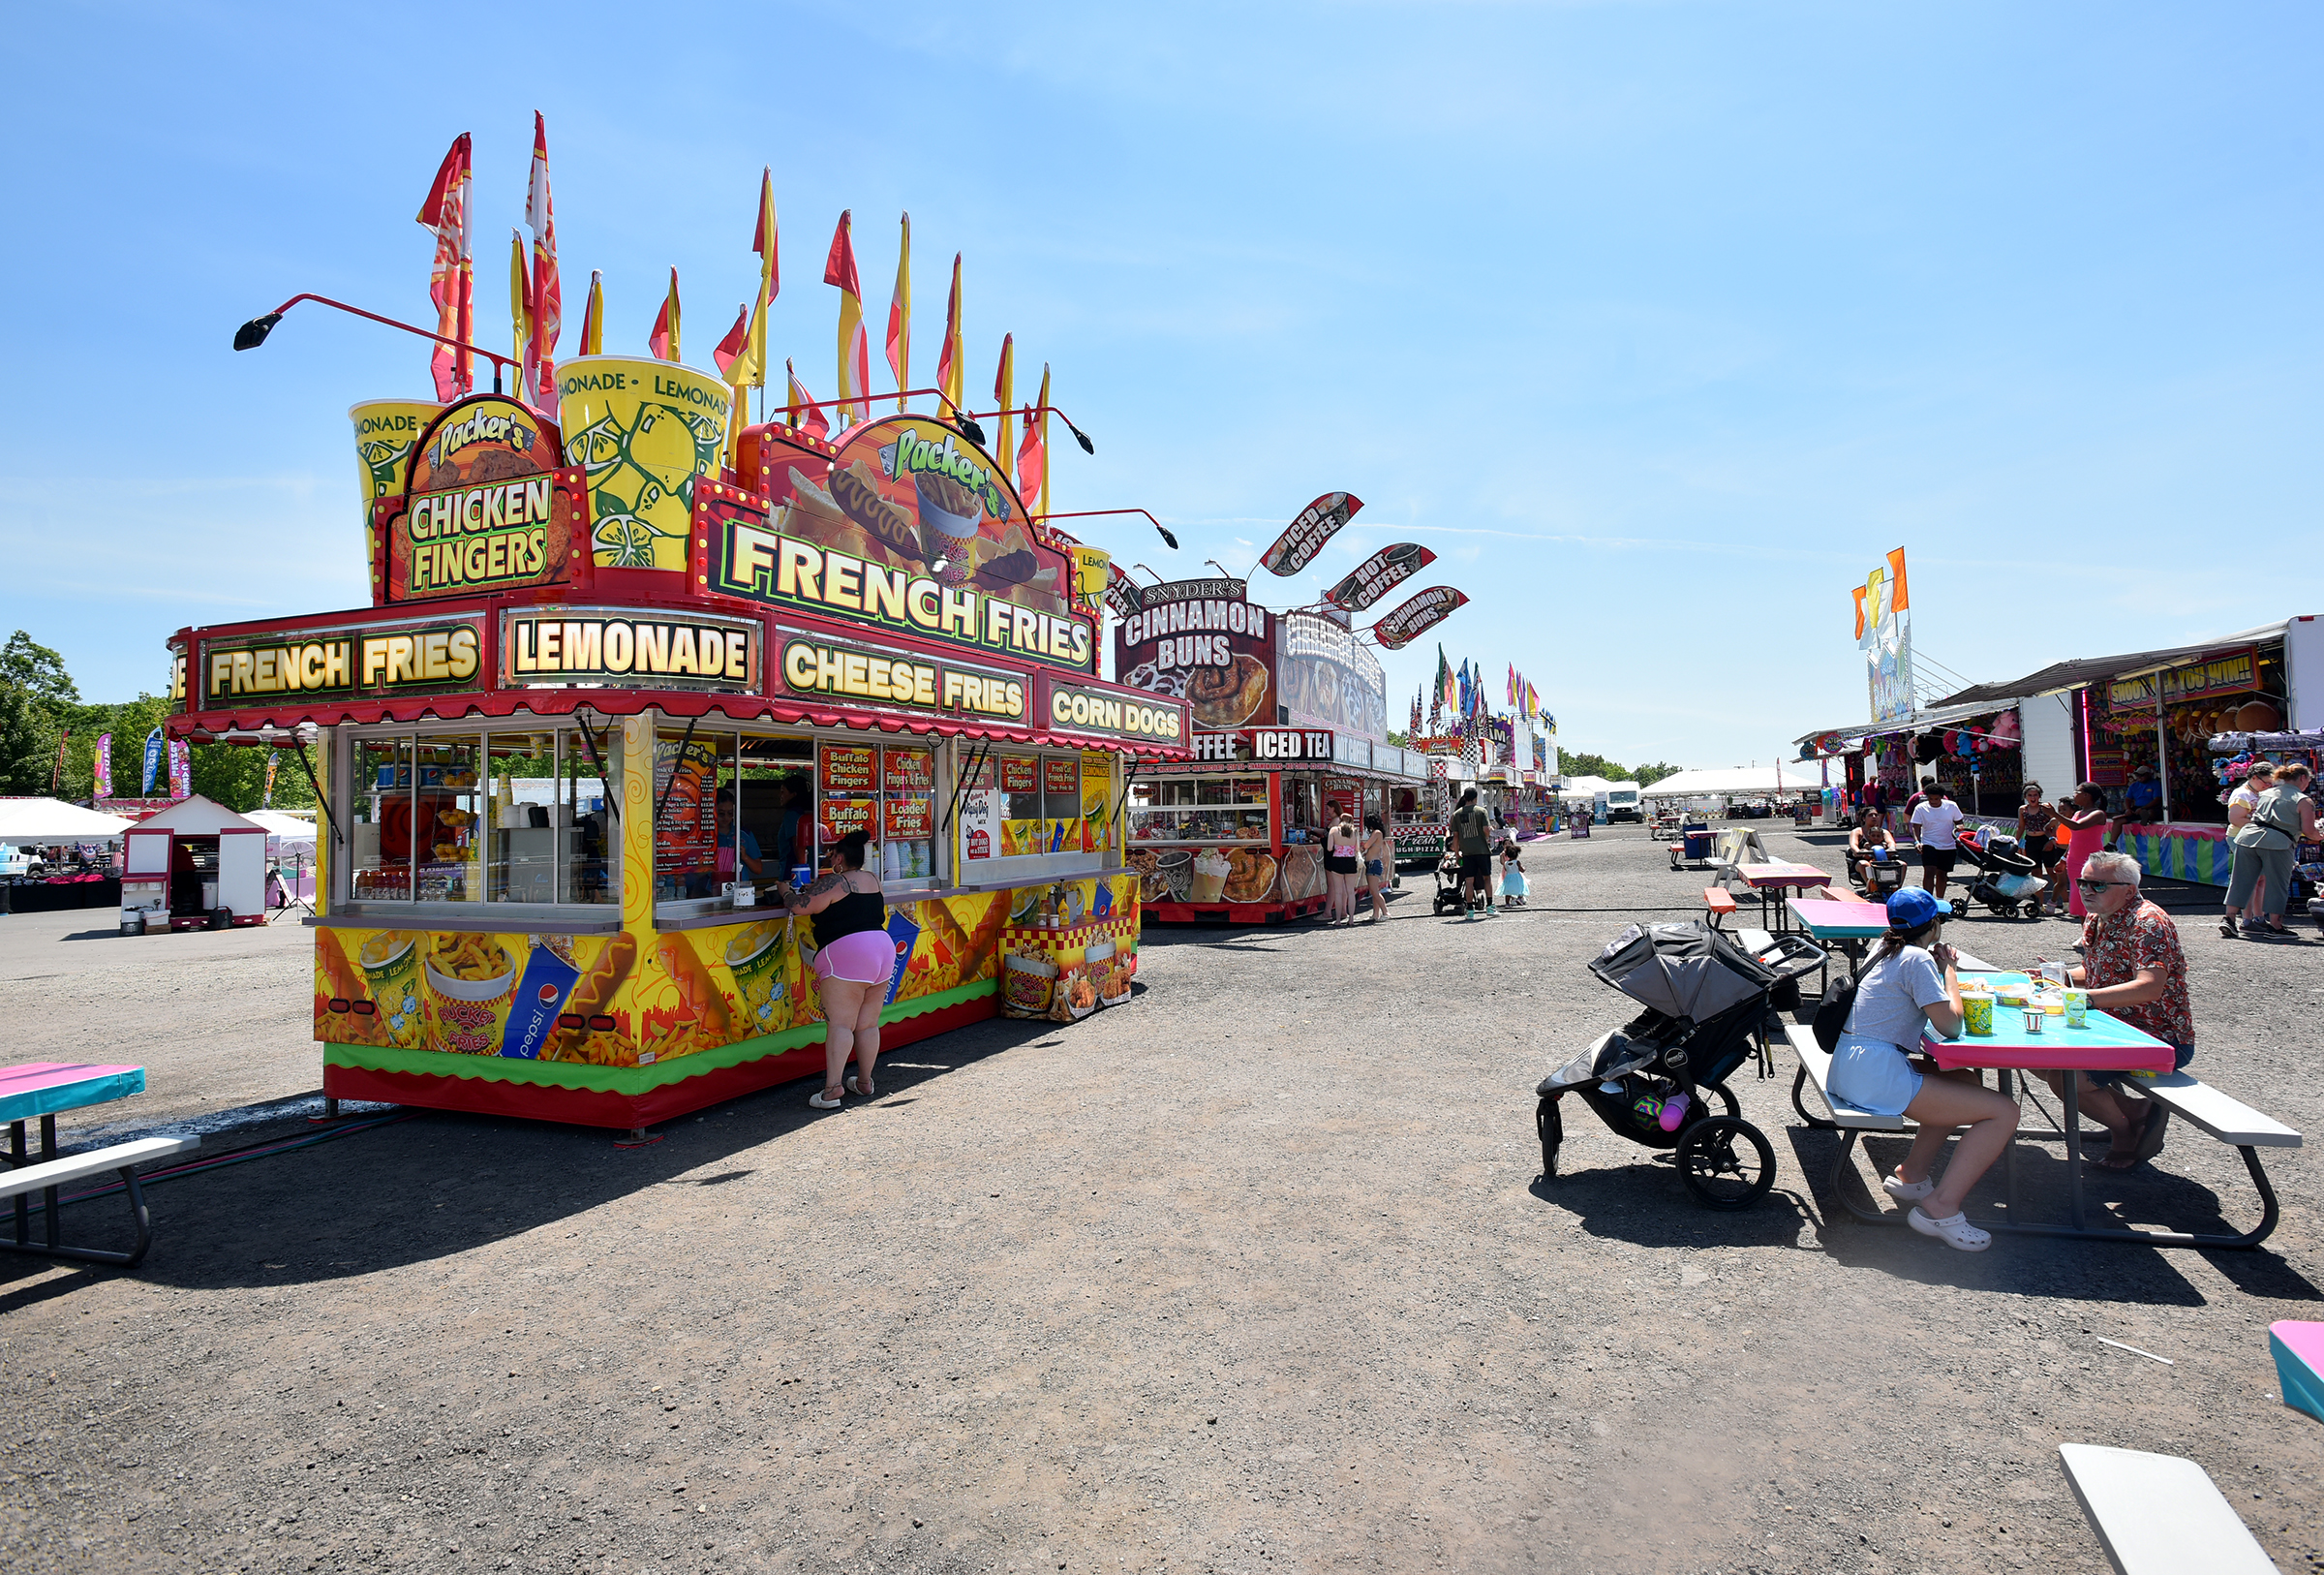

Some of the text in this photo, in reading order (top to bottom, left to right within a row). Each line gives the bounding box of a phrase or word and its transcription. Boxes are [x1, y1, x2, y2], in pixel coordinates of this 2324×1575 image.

[558, 373, 626, 400] EMONADE
[354, 417, 417, 436] EMONADE
[439, 407, 524, 468] Packer's
[892, 428, 1000, 520] Packer's
[412, 479, 550, 540] CHICKEN
[1284, 508, 1320, 548] ICED
[1290, 515, 1339, 571] COFFEE
[413, 529, 547, 590] FINGERS
[1083, 555, 1108, 571] LEMON
[1355, 553, 1388, 586] HOT
[941, 567, 965, 581] RIES
[1357, 562, 1411, 608] COFFEE
[732, 523, 1090, 664] FRENCH FRIES
[1104, 586, 1130, 616] FFEE
[1145, 579, 1242, 604] SNYDER'S
[1125, 601, 1266, 646] CINNAMON
[1391, 590, 1447, 633] CINNAMON
[1406, 606, 1440, 633] BUNS
[210, 641, 350, 695] FRENCH
[364, 629, 477, 686] FRIES
[516, 623, 746, 678] LEMONADE
[1157, 635, 1232, 670] BUNS
[785, 645, 1024, 718] CHEESE FRIES
[2178, 664, 2205, 692] YOU
[2208, 656, 2250, 686] WIN!!
[1053, 690, 1180, 740] CORN DOGS
[657, 740, 709, 763] Pacer's
[830, 752, 869, 763] Buffalo
[1193, 733, 1238, 760] FFEE
[1256, 731, 1330, 758] ICED TEA
[830, 762, 870, 775] Chicken
[897, 757, 921, 771] Chicken
[960, 762, 991, 775] Mzzaella
[1006, 764, 1032, 776] Chicken
[1052, 764, 1063, 773] Fresh
[1083, 765, 1110, 777] LEMONADE
[181, 763, 191, 797] CAKES
[830, 775, 869, 788] Fingers
[887, 772, 909, 788] Fingers
[915, 773, 930, 786] Fries
[1007, 776, 1032, 788] Fingers
[1048, 773, 1075, 783] French Fries
[1325, 778, 1361, 788] CINNAMON
[1333, 783, 1352, 791] BUNS
[101, 799, 145, 808] FUNNEL
[829, 806, 869, 820] Buffalo
[891, 803, 927, 815] Loaded
[835, 820, 864, 835] Fries
[896, 817, 922, 829] Fries
[1400, 834, 1438, 847] Fresh
[367, 950, 415, 980] NADE LEMON
[733, 940, 783, 977] NADE LEMON
[438, 1005, 496, 1025] BUCKET
[449, 1032, 490, 1051] FRIES
[519, 1008, 544, 1057] pepsi
